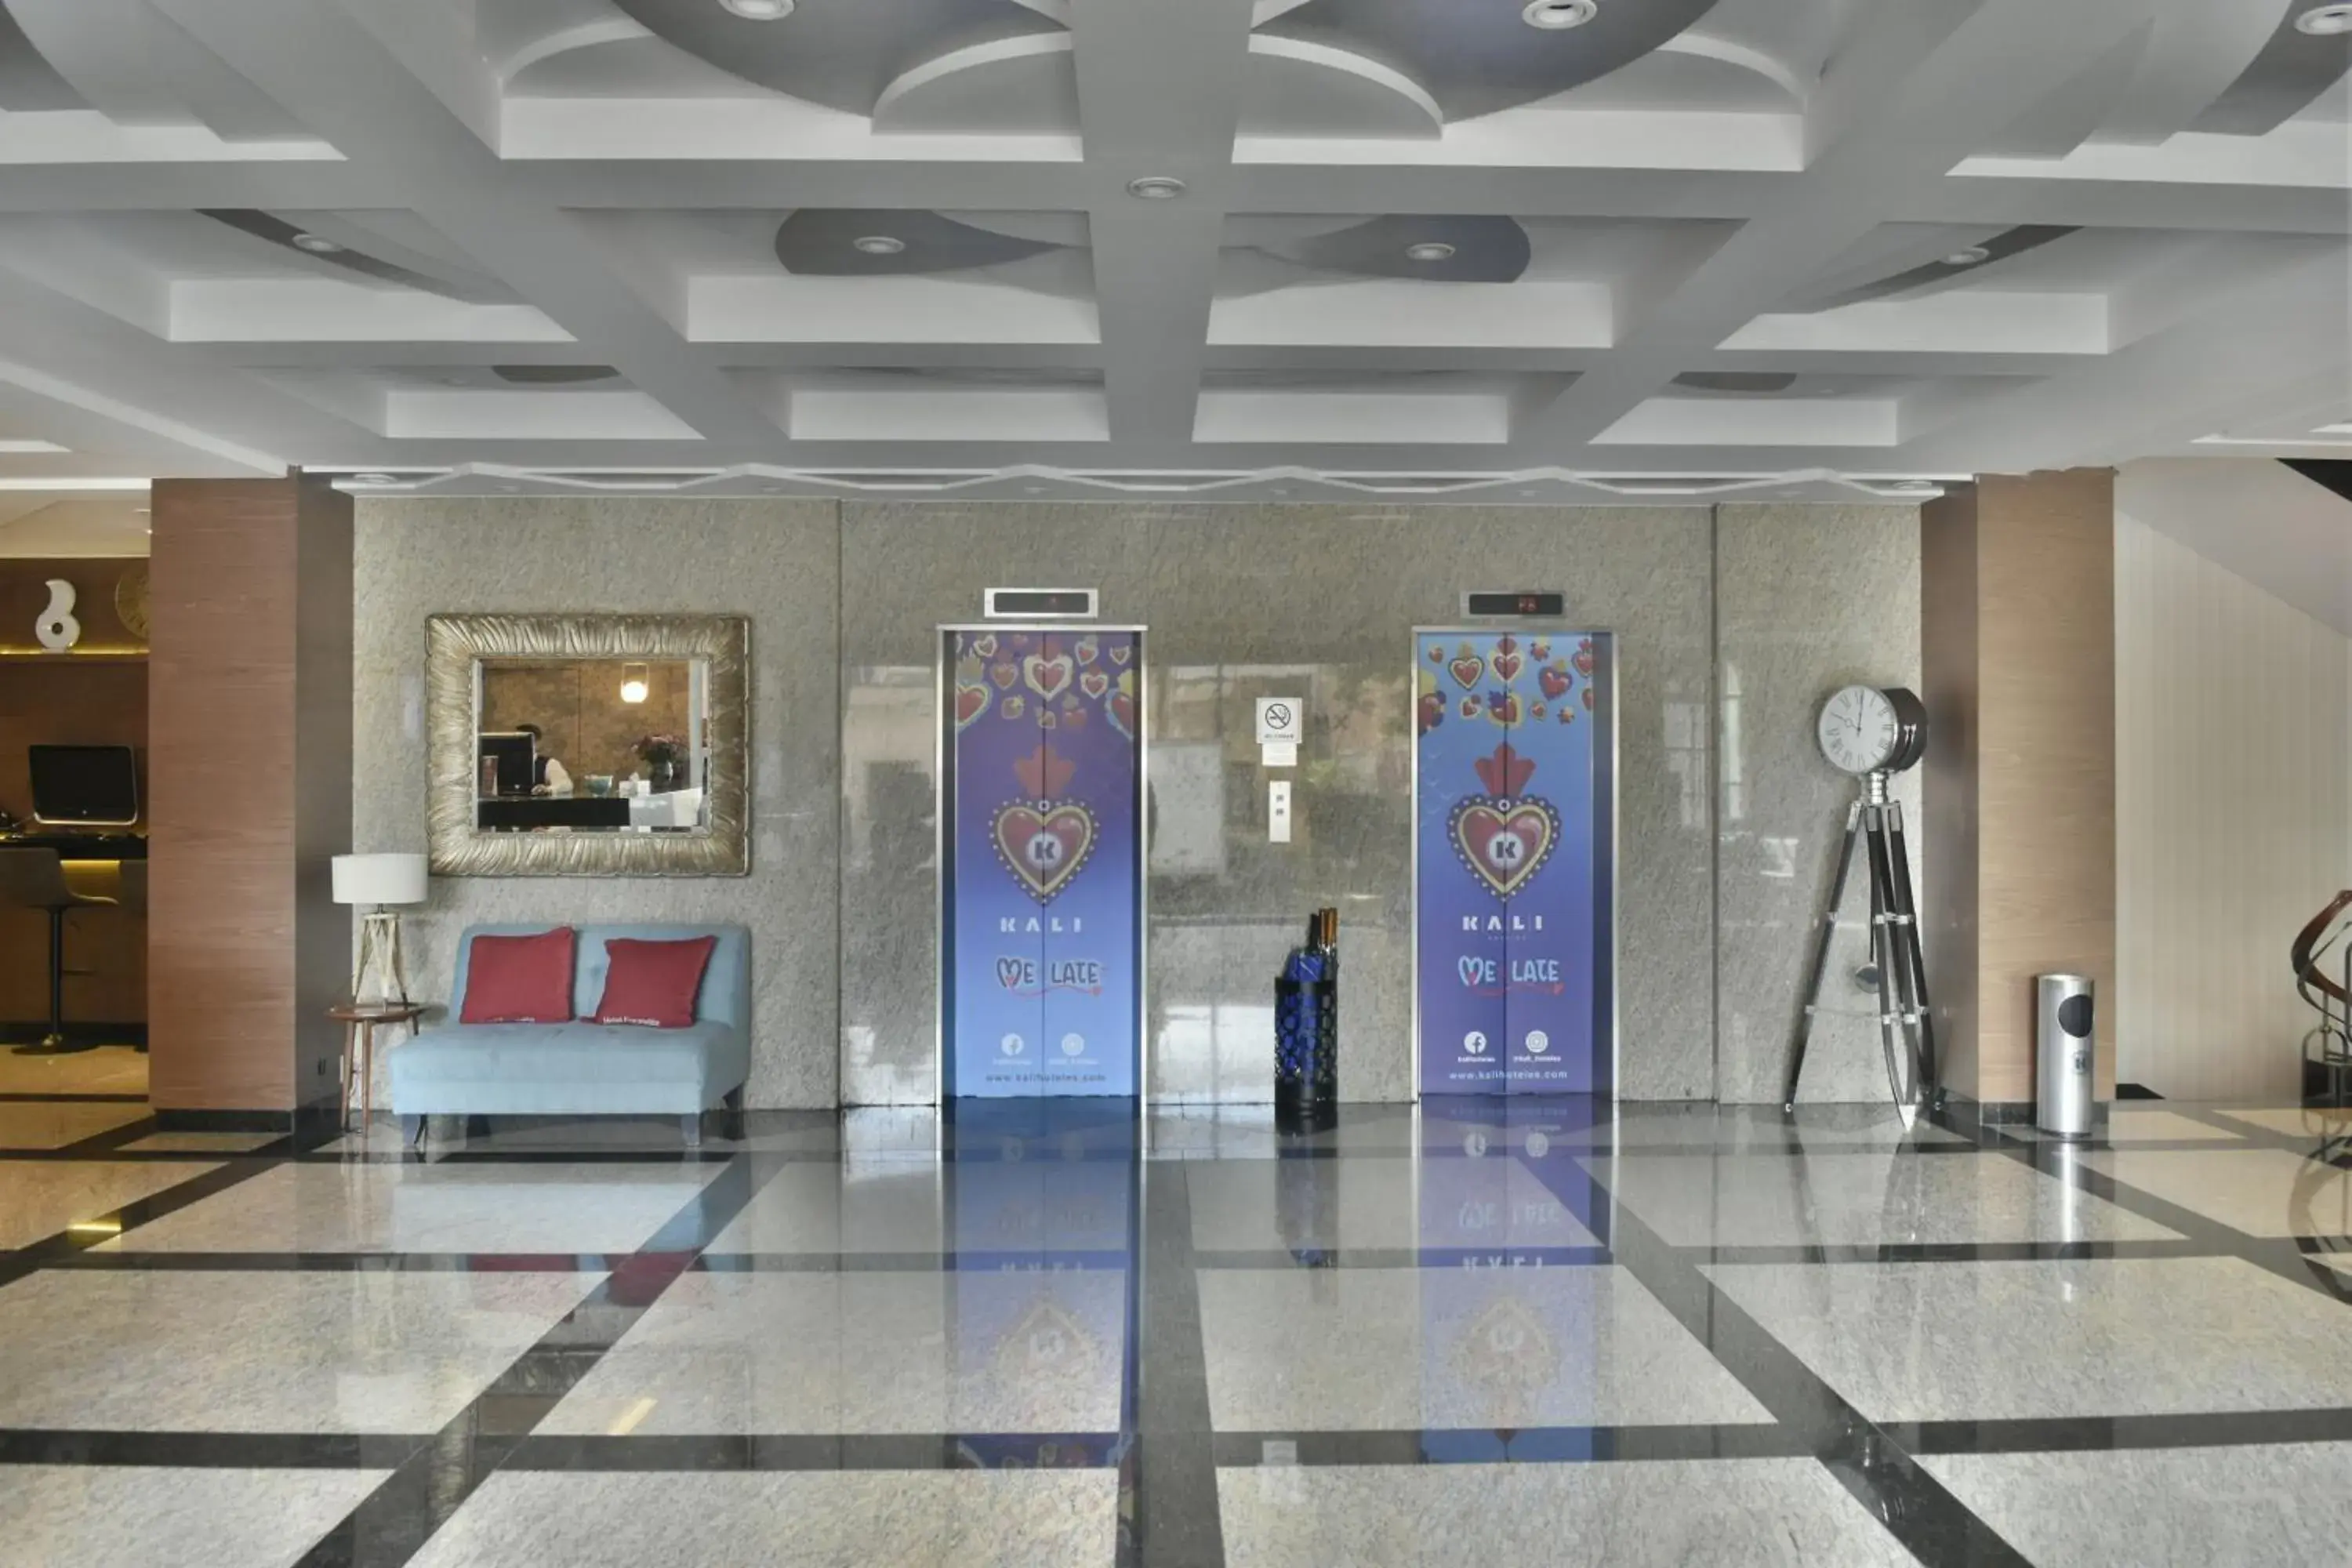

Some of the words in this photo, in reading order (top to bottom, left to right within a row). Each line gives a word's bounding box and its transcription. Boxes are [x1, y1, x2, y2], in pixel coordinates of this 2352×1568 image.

[1035, 841, 1055, 860] K
[1496, 840, 1515, 859] K
[1000, 916, 1081, 933] KALI
[1462, 915, 1543, 931] KALI
[1051, 961, 1099, 985] LATE
[1512, 959, 1559, 982] LATE
